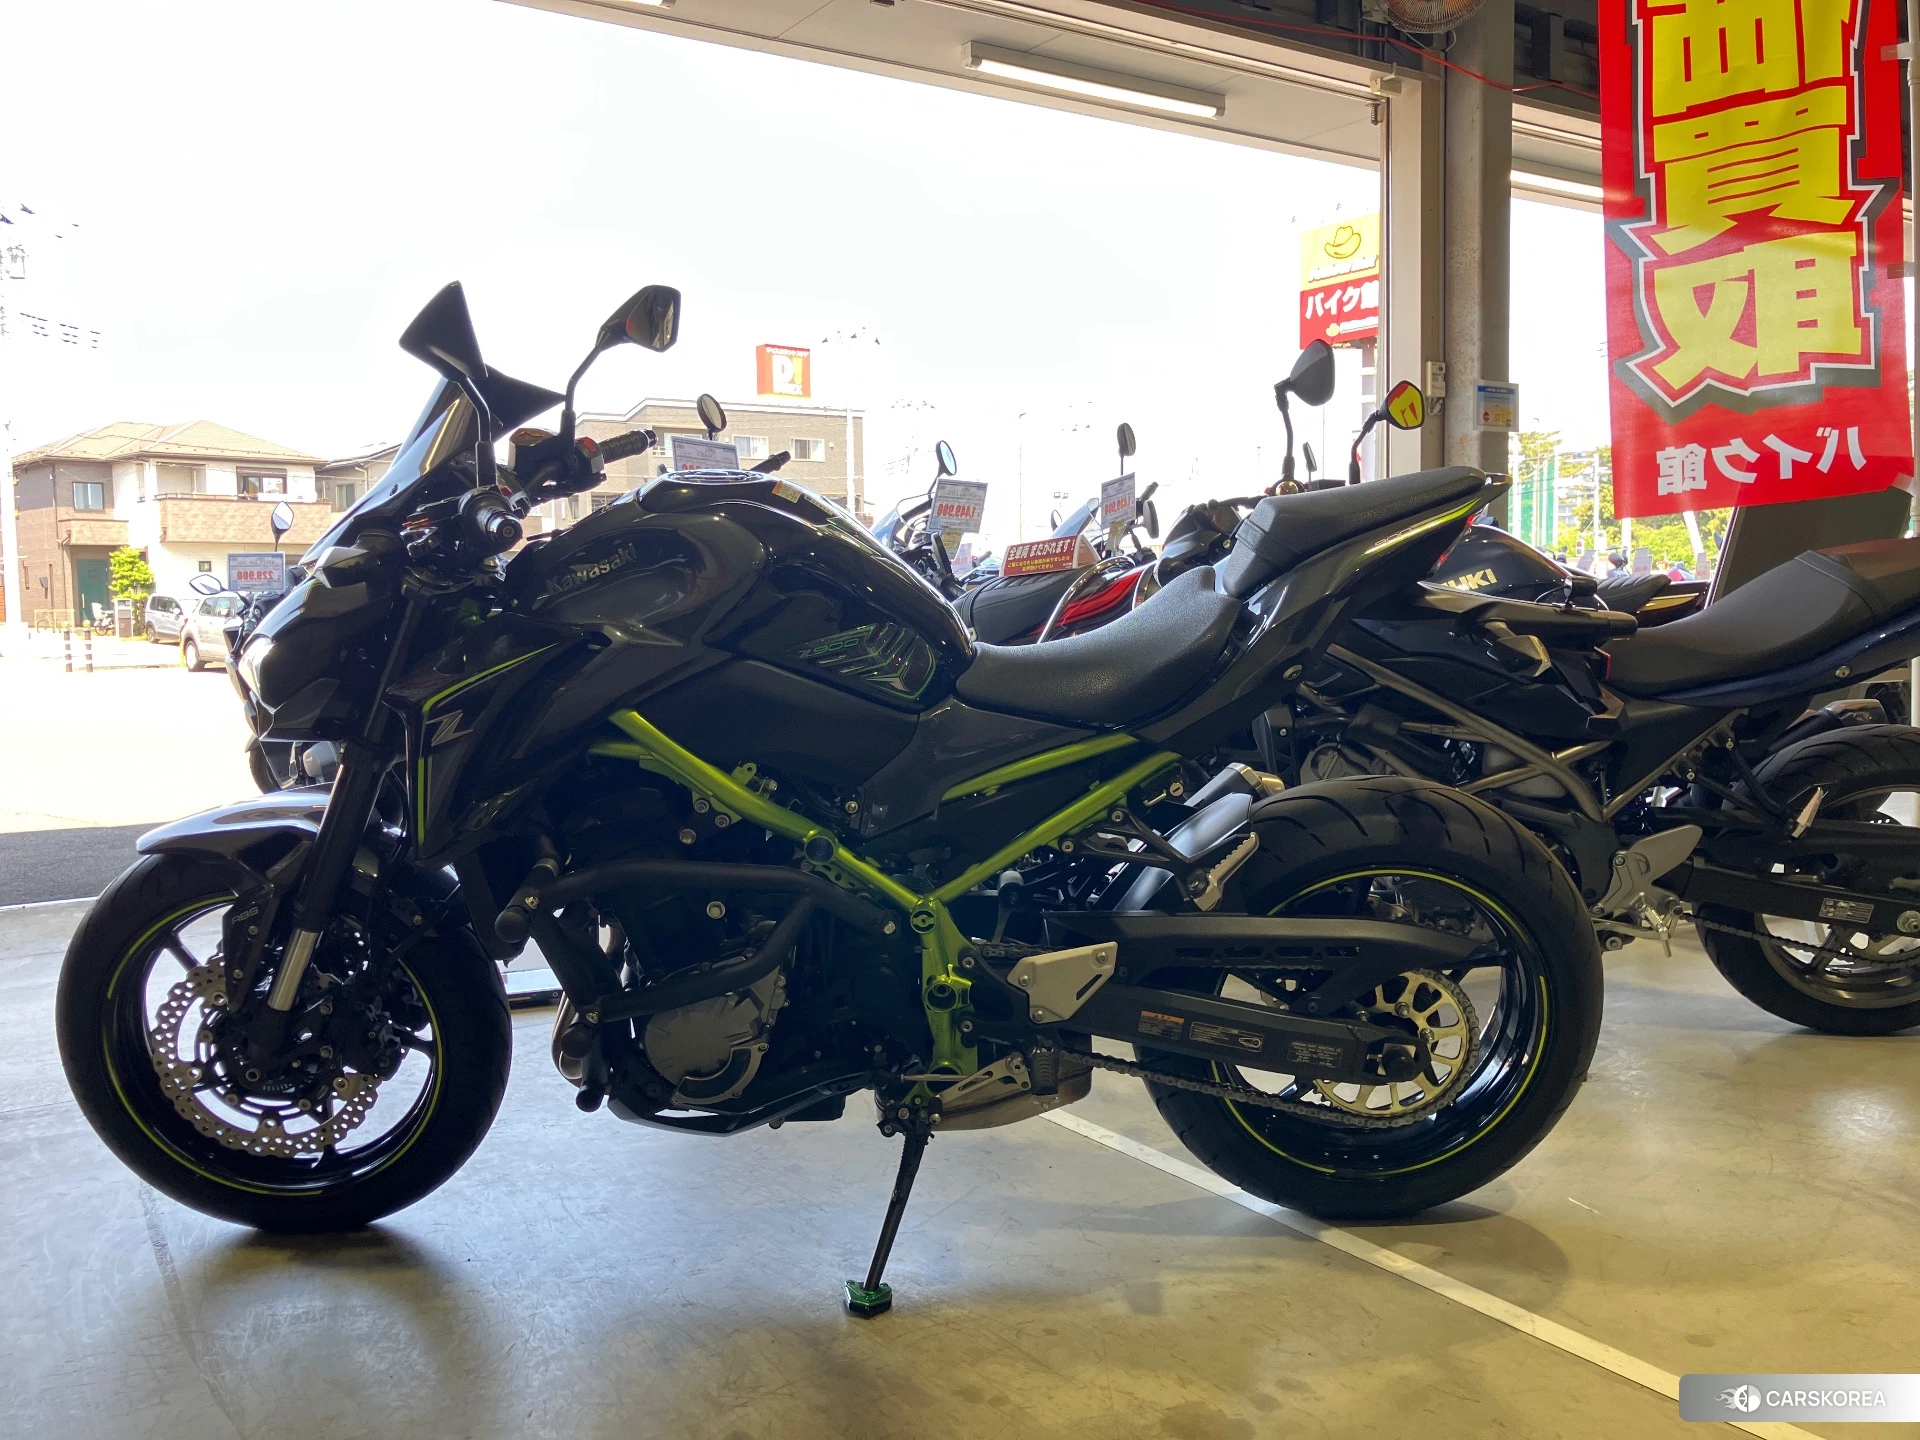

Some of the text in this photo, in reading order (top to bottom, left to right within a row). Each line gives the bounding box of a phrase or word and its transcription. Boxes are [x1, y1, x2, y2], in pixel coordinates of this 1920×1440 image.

[1007, 544, 1031, 561] 全車両
[545, 542, 638, 594] Kawasaki
[798, 638, 860, 659] Z900
[232, 906, 259, 925] ABS
